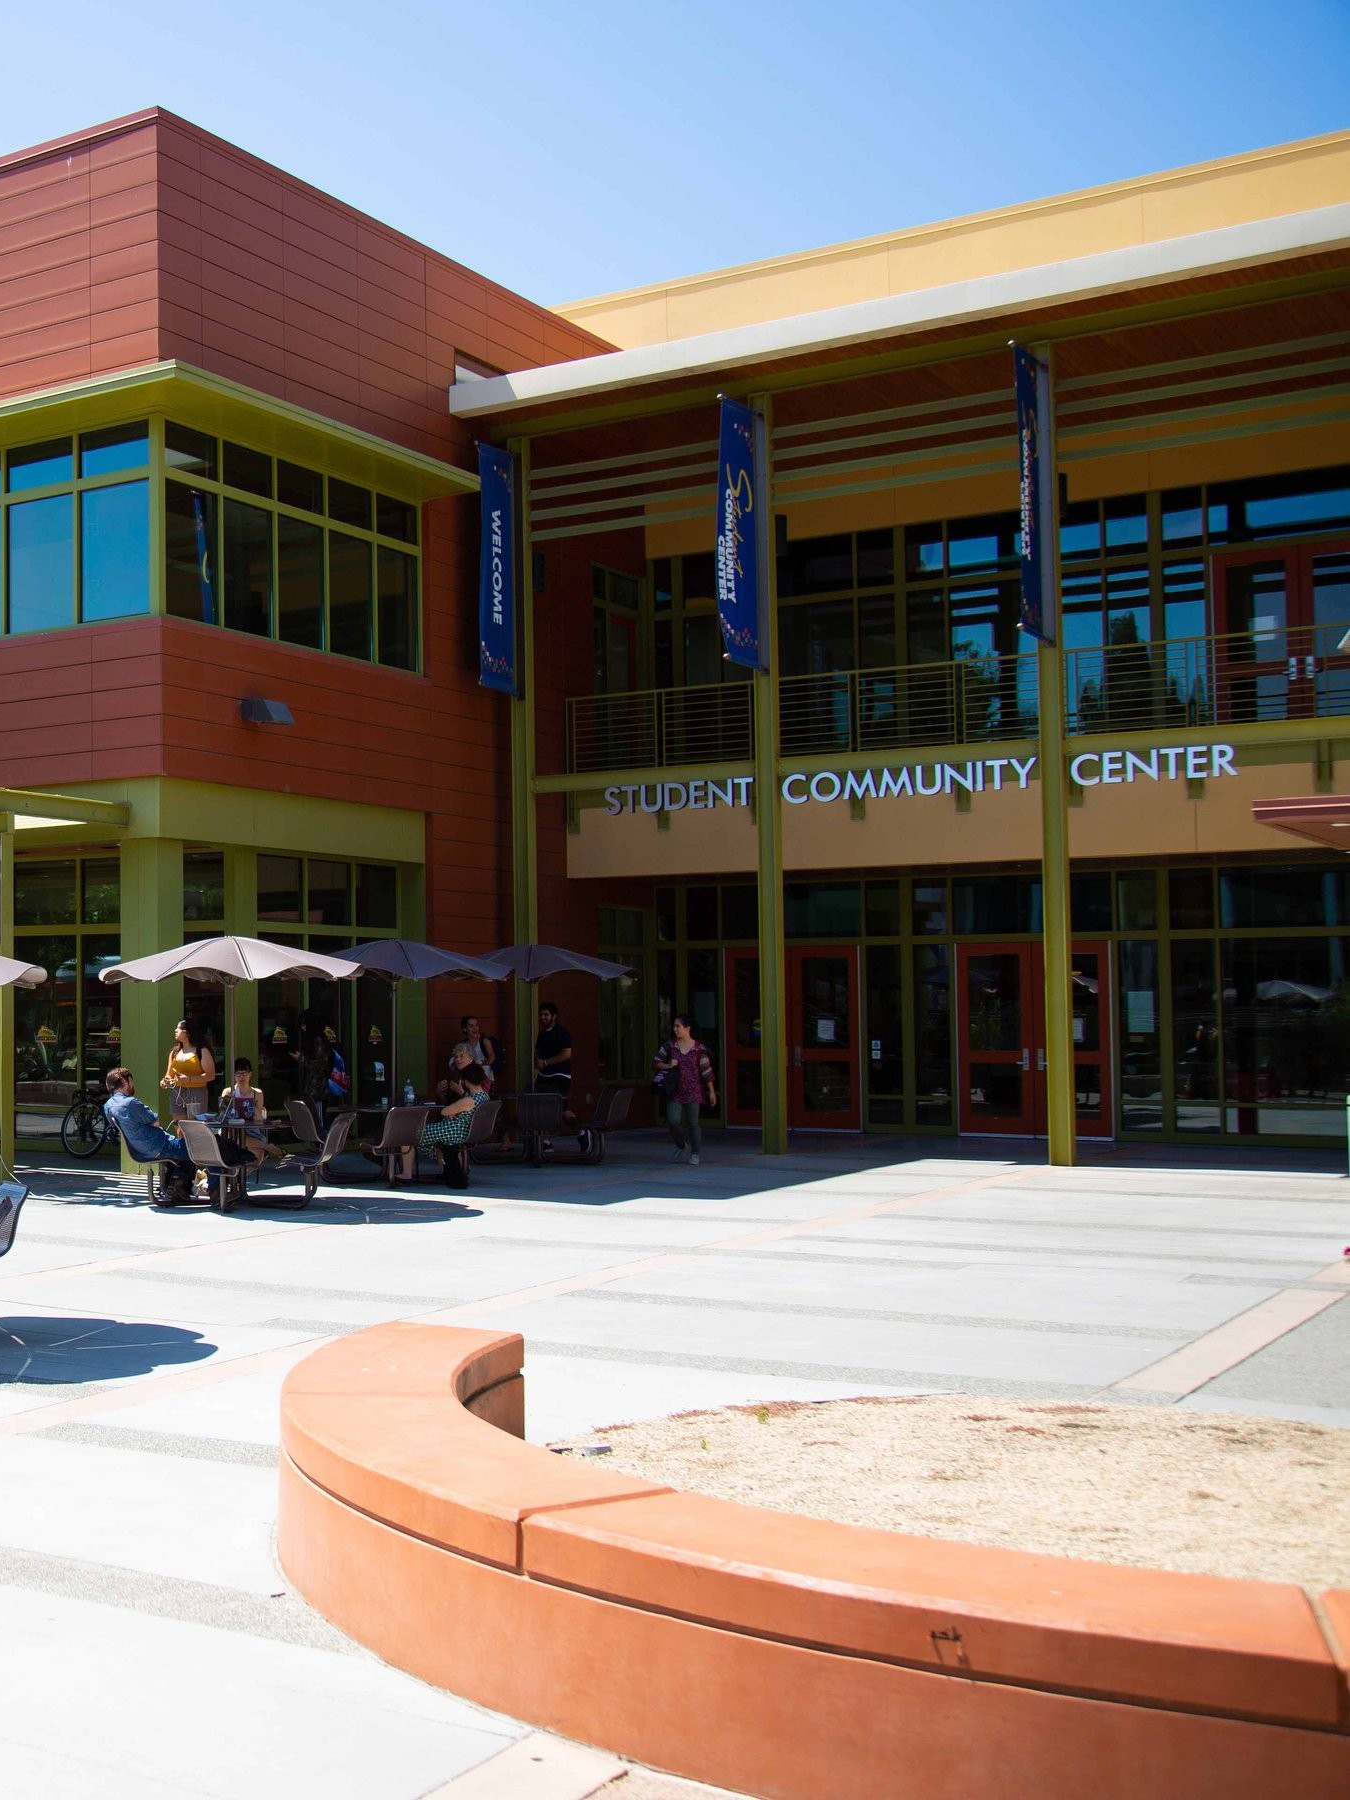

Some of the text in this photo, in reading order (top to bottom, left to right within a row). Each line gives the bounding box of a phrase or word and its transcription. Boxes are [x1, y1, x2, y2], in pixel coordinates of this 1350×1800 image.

[492, 510, 503, 625] WELCOME
[718, 535, 728, 601] CENTER
[725, 488, 737, 604] COMMUNITY
[604, 744, 1240, 816] STUDENT COMMUNITY CENTER
